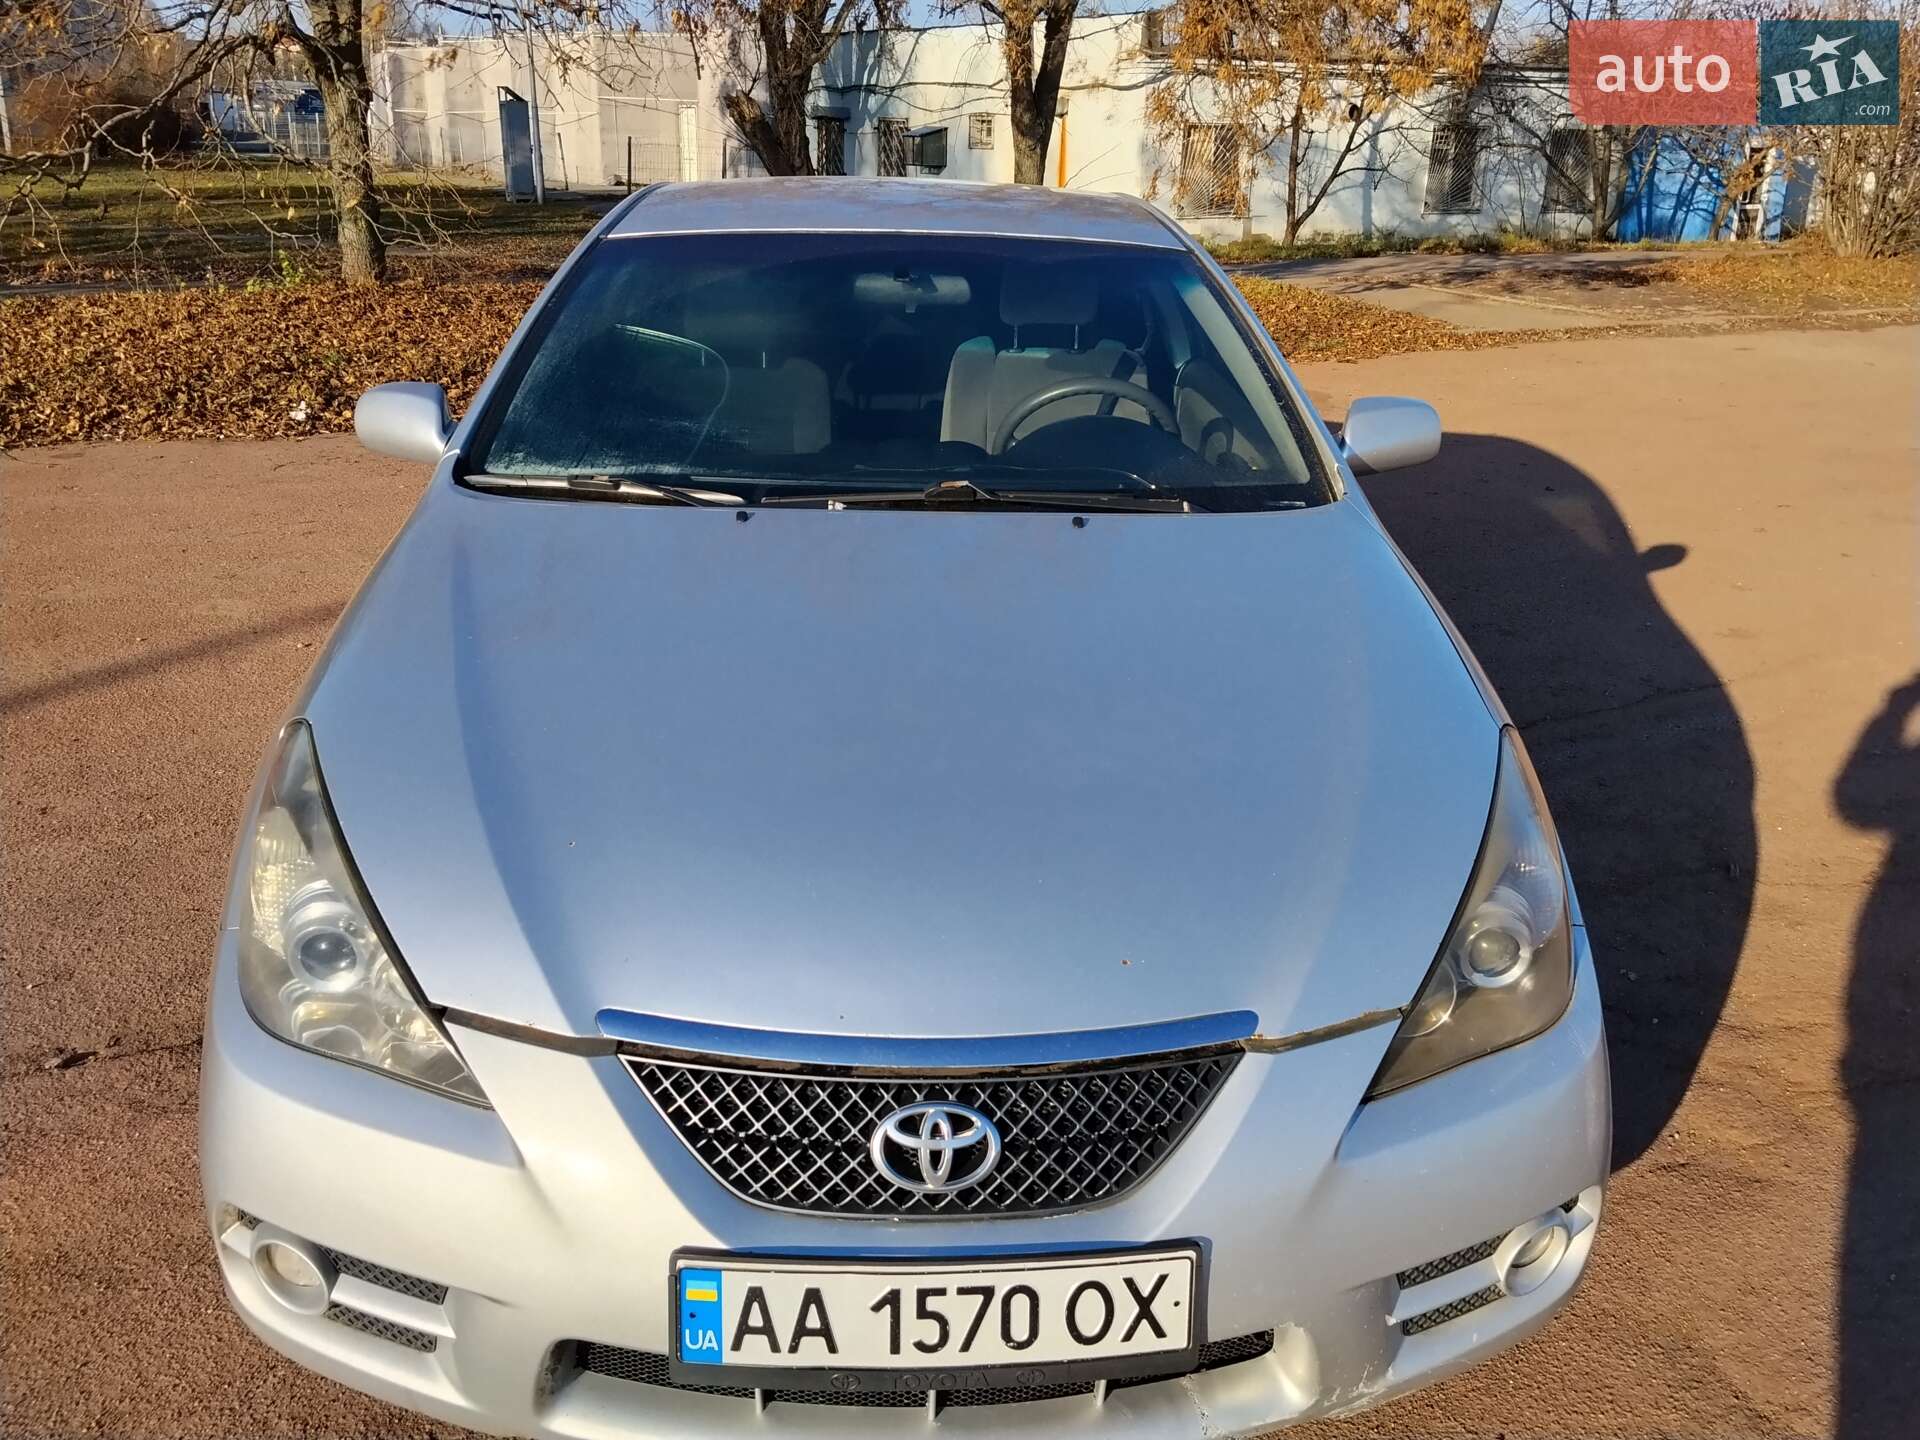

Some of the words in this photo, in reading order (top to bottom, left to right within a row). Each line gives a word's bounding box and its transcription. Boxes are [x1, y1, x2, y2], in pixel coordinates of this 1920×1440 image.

[730, 1285, 839, 1354] AA
[869, 1284, 1040, 1355] 1570
[1065, 1273, 1170, 1347] OX
[684, 1328, 718, 1351] UA
[892, 1371, 991, 1390] TOYOTA
